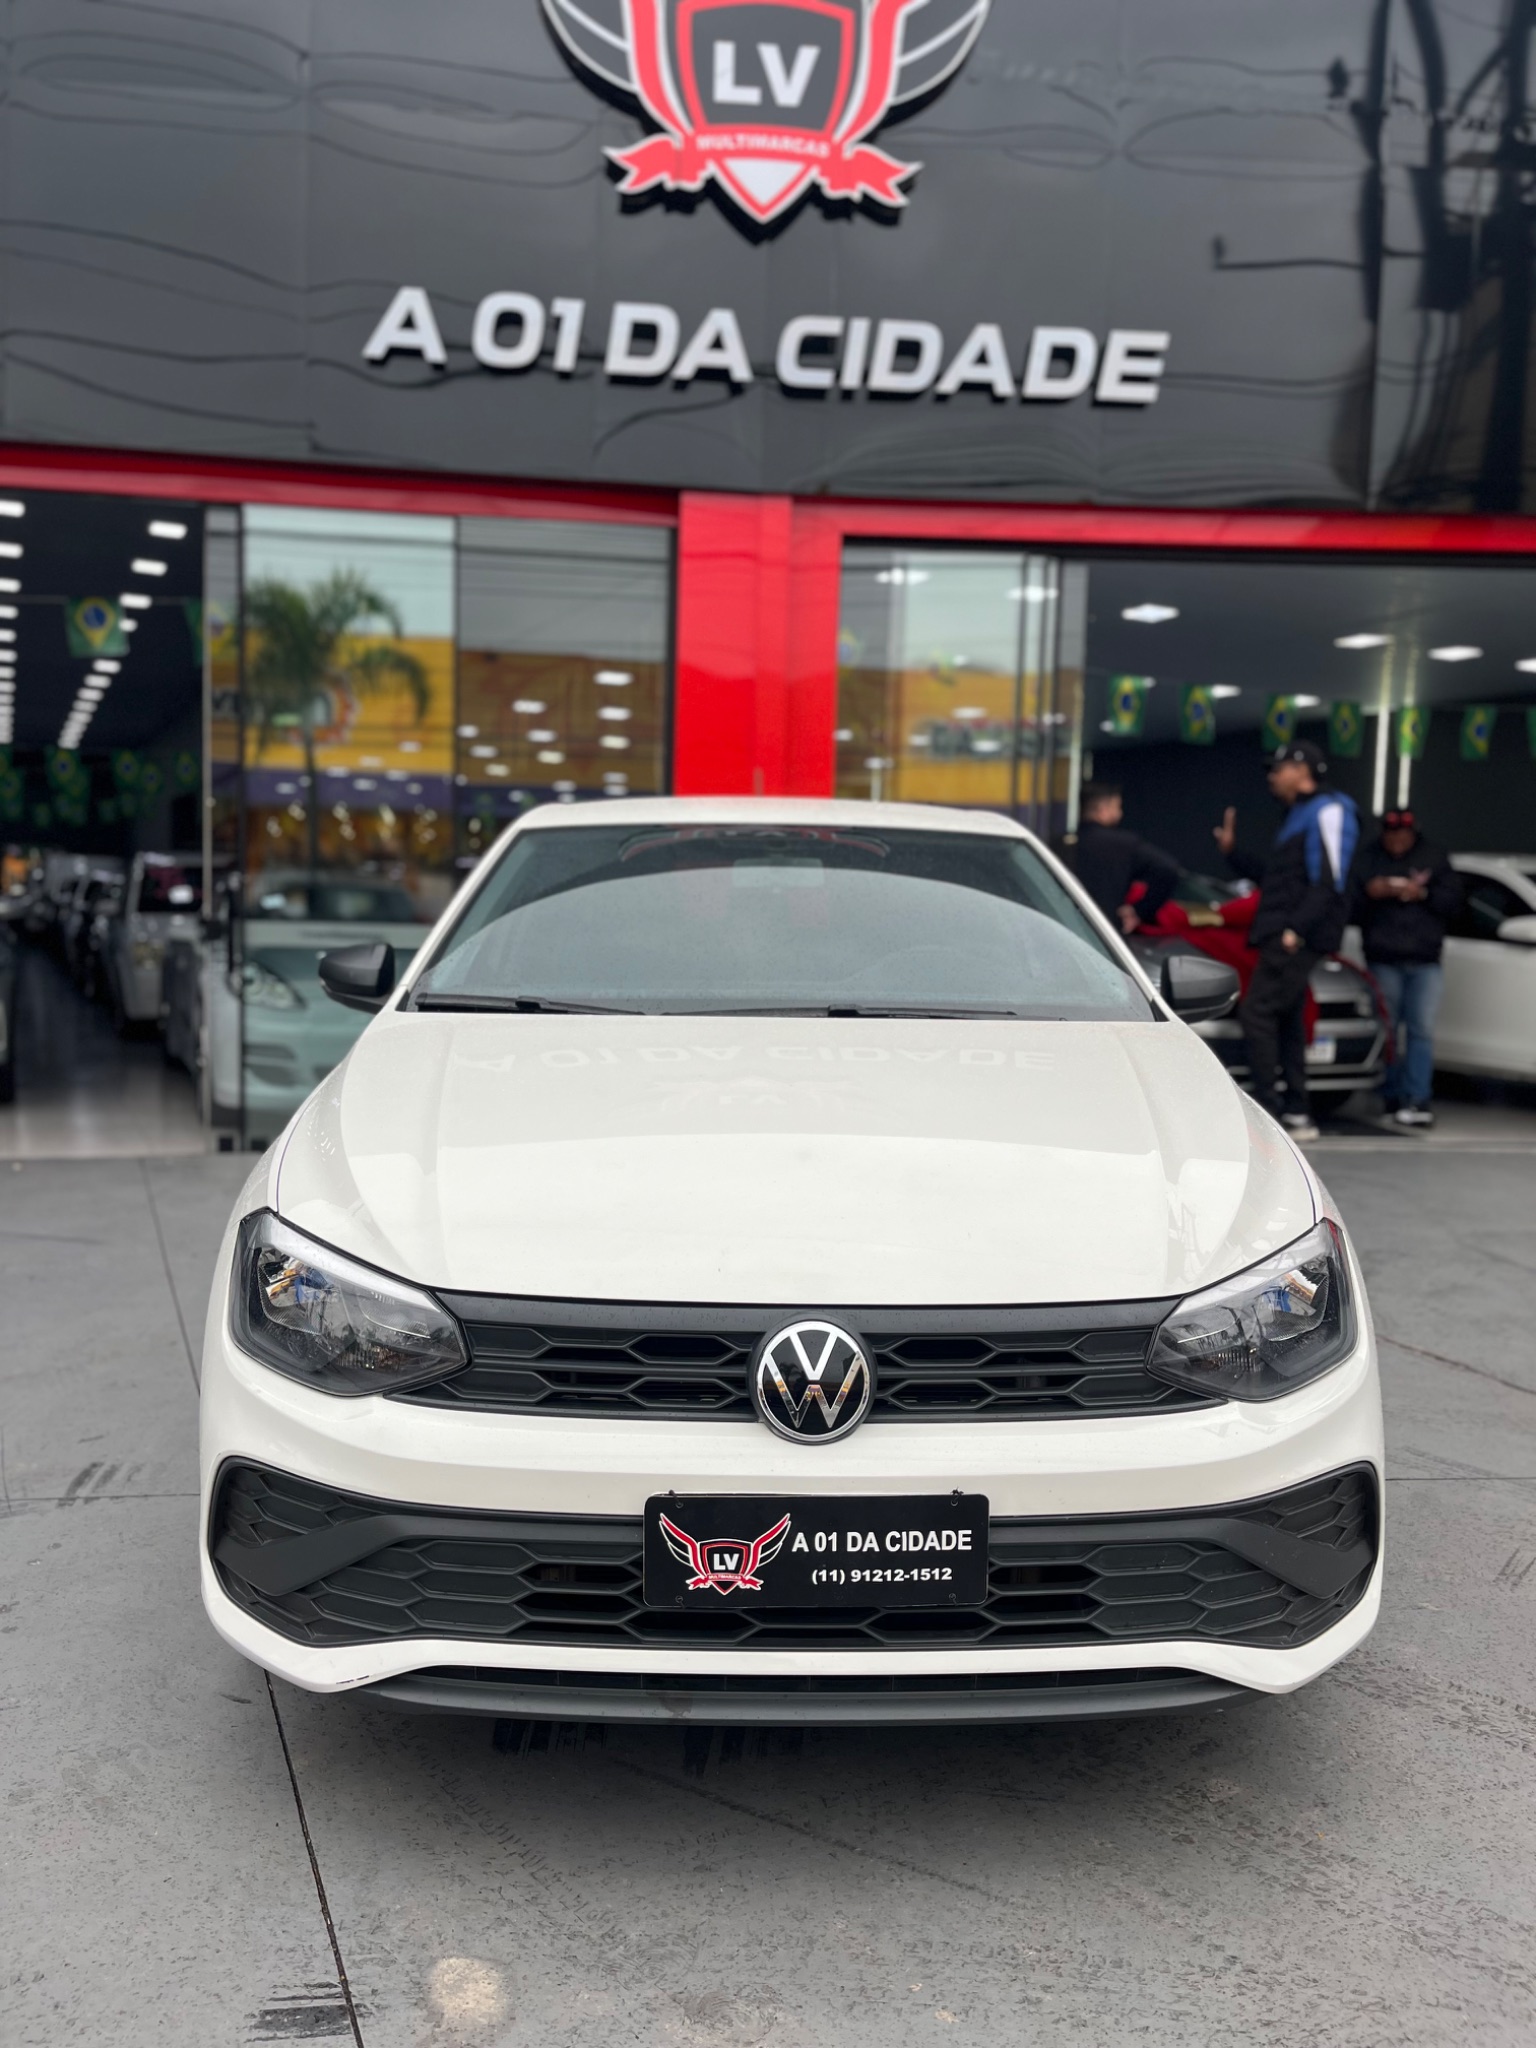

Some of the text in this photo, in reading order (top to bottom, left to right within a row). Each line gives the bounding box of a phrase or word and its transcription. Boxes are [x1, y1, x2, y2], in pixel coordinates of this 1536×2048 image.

[712, 40, 820, 107] LV
[363, 287, 1170, 403] A 01 DA CIDADE
[792, 1530, 972, 1552] A 01 DA CIDADE
[713, 1553, 740, 1570] LV
[811, 1567, 952, 1585] (11) 91212-1512
